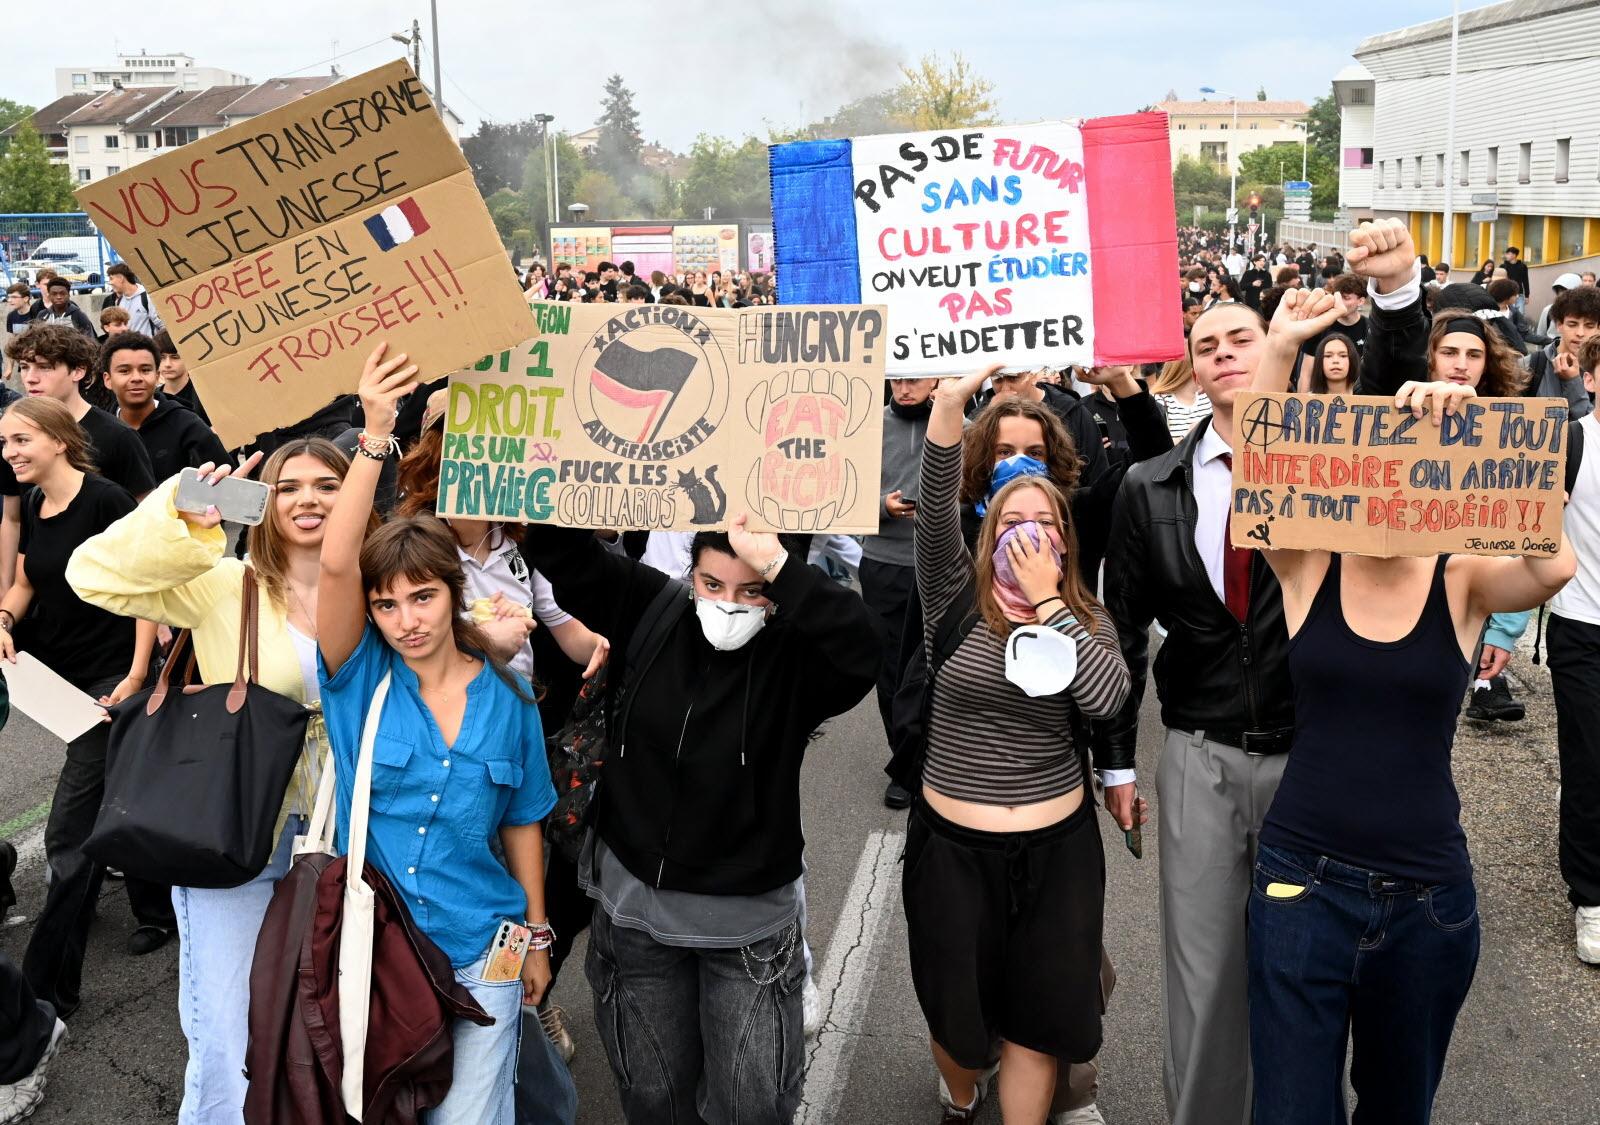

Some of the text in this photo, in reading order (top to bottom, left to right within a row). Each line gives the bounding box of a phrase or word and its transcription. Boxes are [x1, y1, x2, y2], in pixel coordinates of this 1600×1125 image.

[855, 133, 1084, 213] PAS DE FUTUR
[921, 175, 1022, 213] SANS
[90, 159, 237, 234] VOUS
[134, 150, 407, 289] LA JEUNESSE
[878, 210, 1069, 261] CULTURE
[165, 230, 349, 323] DORÉE EN
[872, 268, 905, 292] ON
[909, 262, 982, 288] VEUT
[179, 257, 373, 361] JEUNESSE
[939, 288, 1013, 323] PAS
[738, 309, 882, 363] HUNGRY?
[893, 315, 1084, 360] S'ENDETTER
[527, 341, 554, 377] 1
[765, 395, 846, 449] EAT
[1241, 396, 1569, 453] ARRÊTEZ DE TOUT
[444, 432, 526, 463] PAS UN
[777, 437, 826, 459] THE
[560, 460, 668, 485] FUCK LES
[1409, 458, 1450, 490] ON
[558, 484, 676, 528] COLLABOS
[1235, 487, 1273, 514] PAS
[1279, 485, 1296, 518] À
[1302, 493, 1360, 521] TOUT
[1465, 538, 1516, 550] Jeunesse
